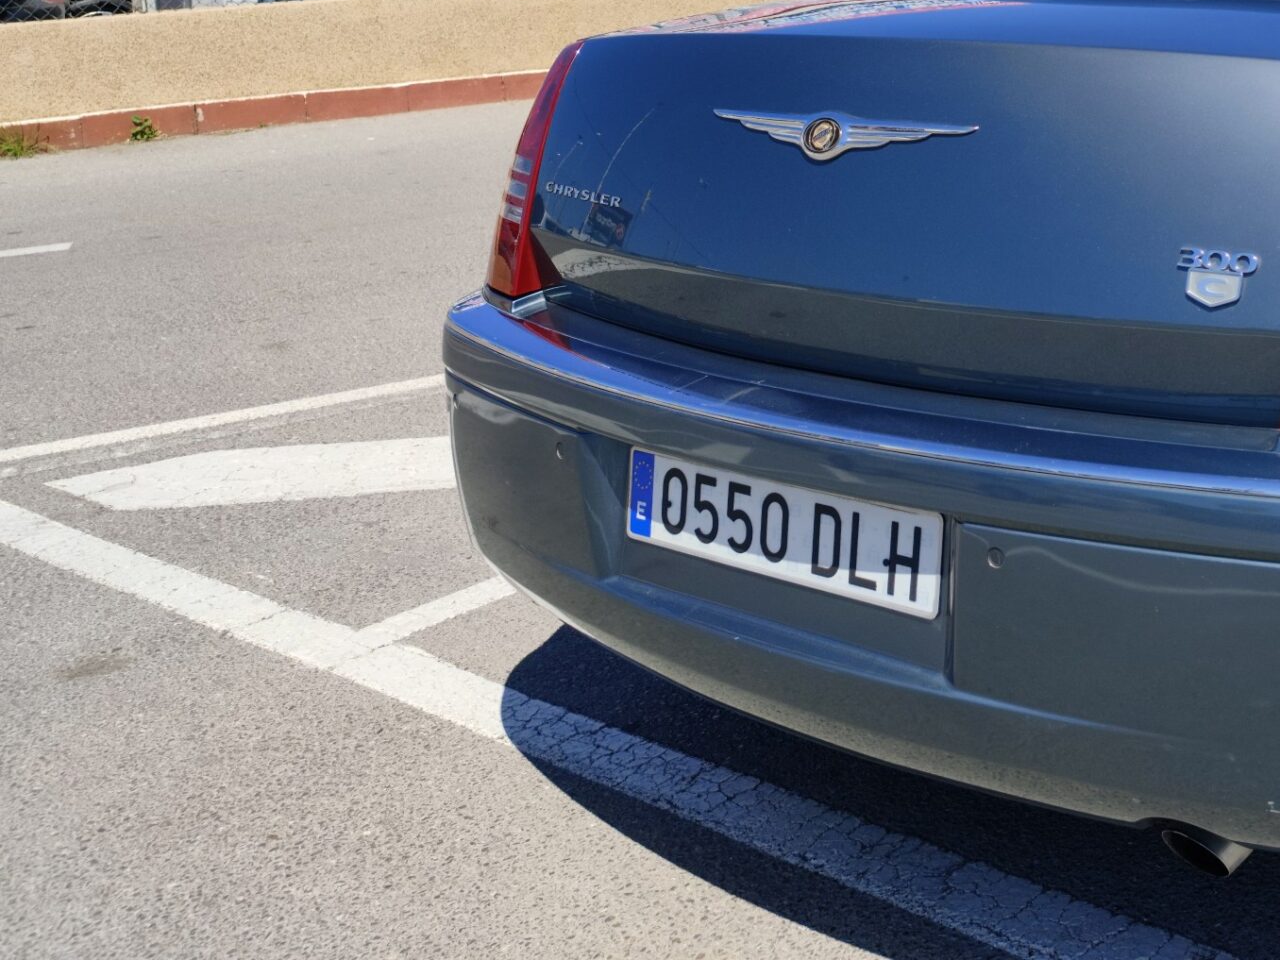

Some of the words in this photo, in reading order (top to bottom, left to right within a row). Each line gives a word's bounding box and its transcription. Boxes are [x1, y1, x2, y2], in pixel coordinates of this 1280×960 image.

[545, 181, 621, 208] CHRYSLER
[1177, 247, 1260, 276] 300
[635, 500, 647, 521] E
[661, 467, 789, 563] 0550
[811, 503, 922, 602] DLH
